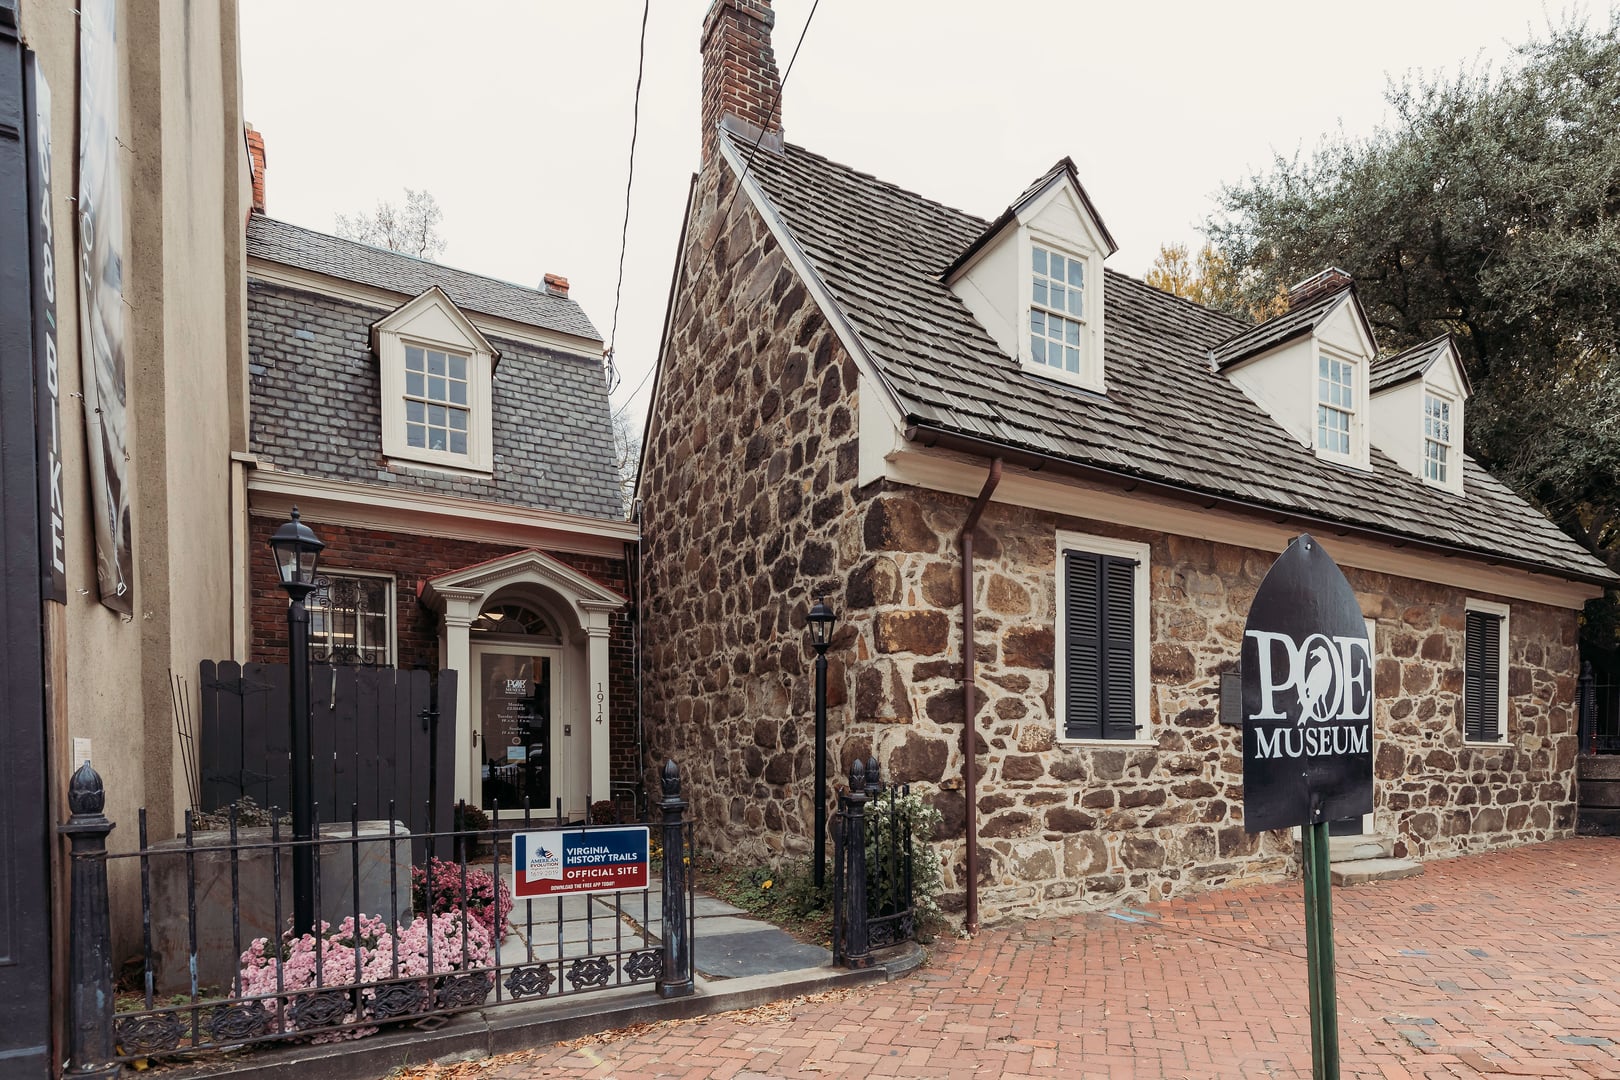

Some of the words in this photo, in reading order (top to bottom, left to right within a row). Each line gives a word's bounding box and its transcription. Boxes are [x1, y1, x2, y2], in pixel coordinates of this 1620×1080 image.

[1245, 629, 1372, 723] POE
[595, 682, 604, 725] 1914
[1254, 724, 1369, 759] MUSEUM
[566, 846, 610, 856] VIRGINIA
[567, 854, 607, 865] HISTORY
[608, 852, 638, 862] TRAILS
[566, 868, 615, 879] OFFICIAL
[617, 866, 639, 875] SITE
